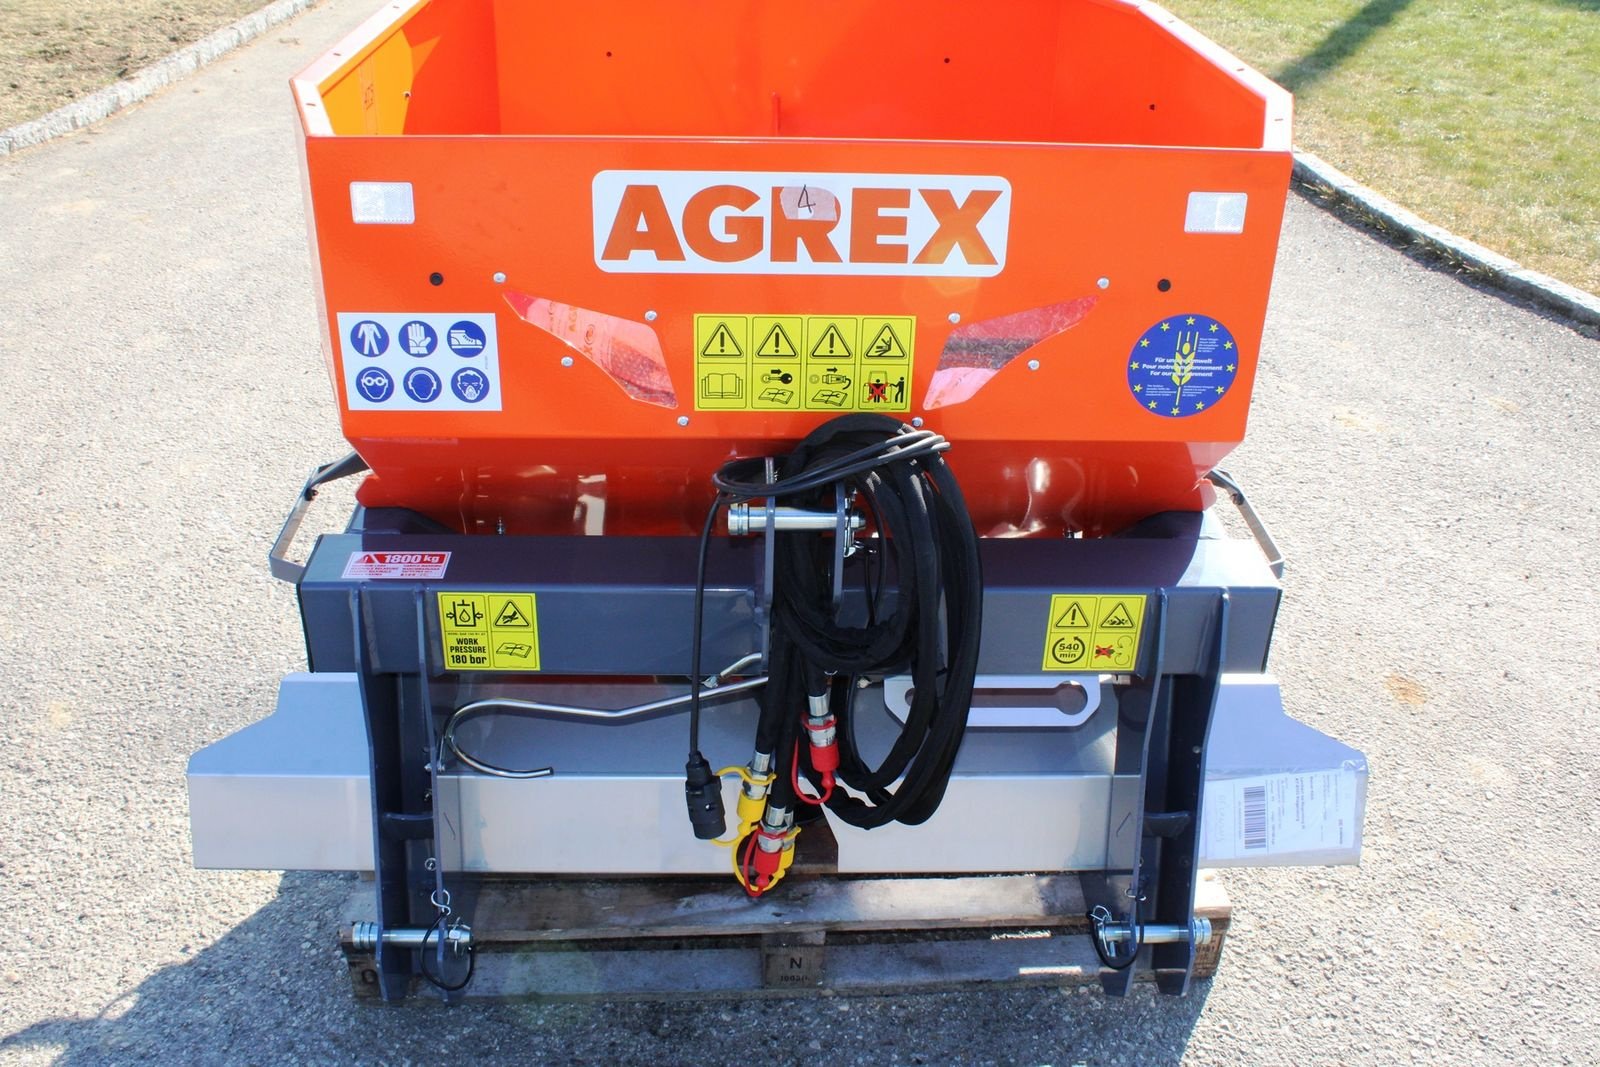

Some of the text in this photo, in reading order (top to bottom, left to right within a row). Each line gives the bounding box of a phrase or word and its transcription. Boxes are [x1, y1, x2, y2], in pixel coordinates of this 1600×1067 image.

[797, 184, 817, 214] 4
[601, 184, 1004, 266] AGREX
[384, 553, 440, 564] 1800 kg
[456, 637, 479, 646] WORK
[1059, 643, 1079, 651] 540
[449, 645, 487, 654] PRESSURE
[450, 654, 487, 665] 180 bar
[789, 957, 802, 969] N
